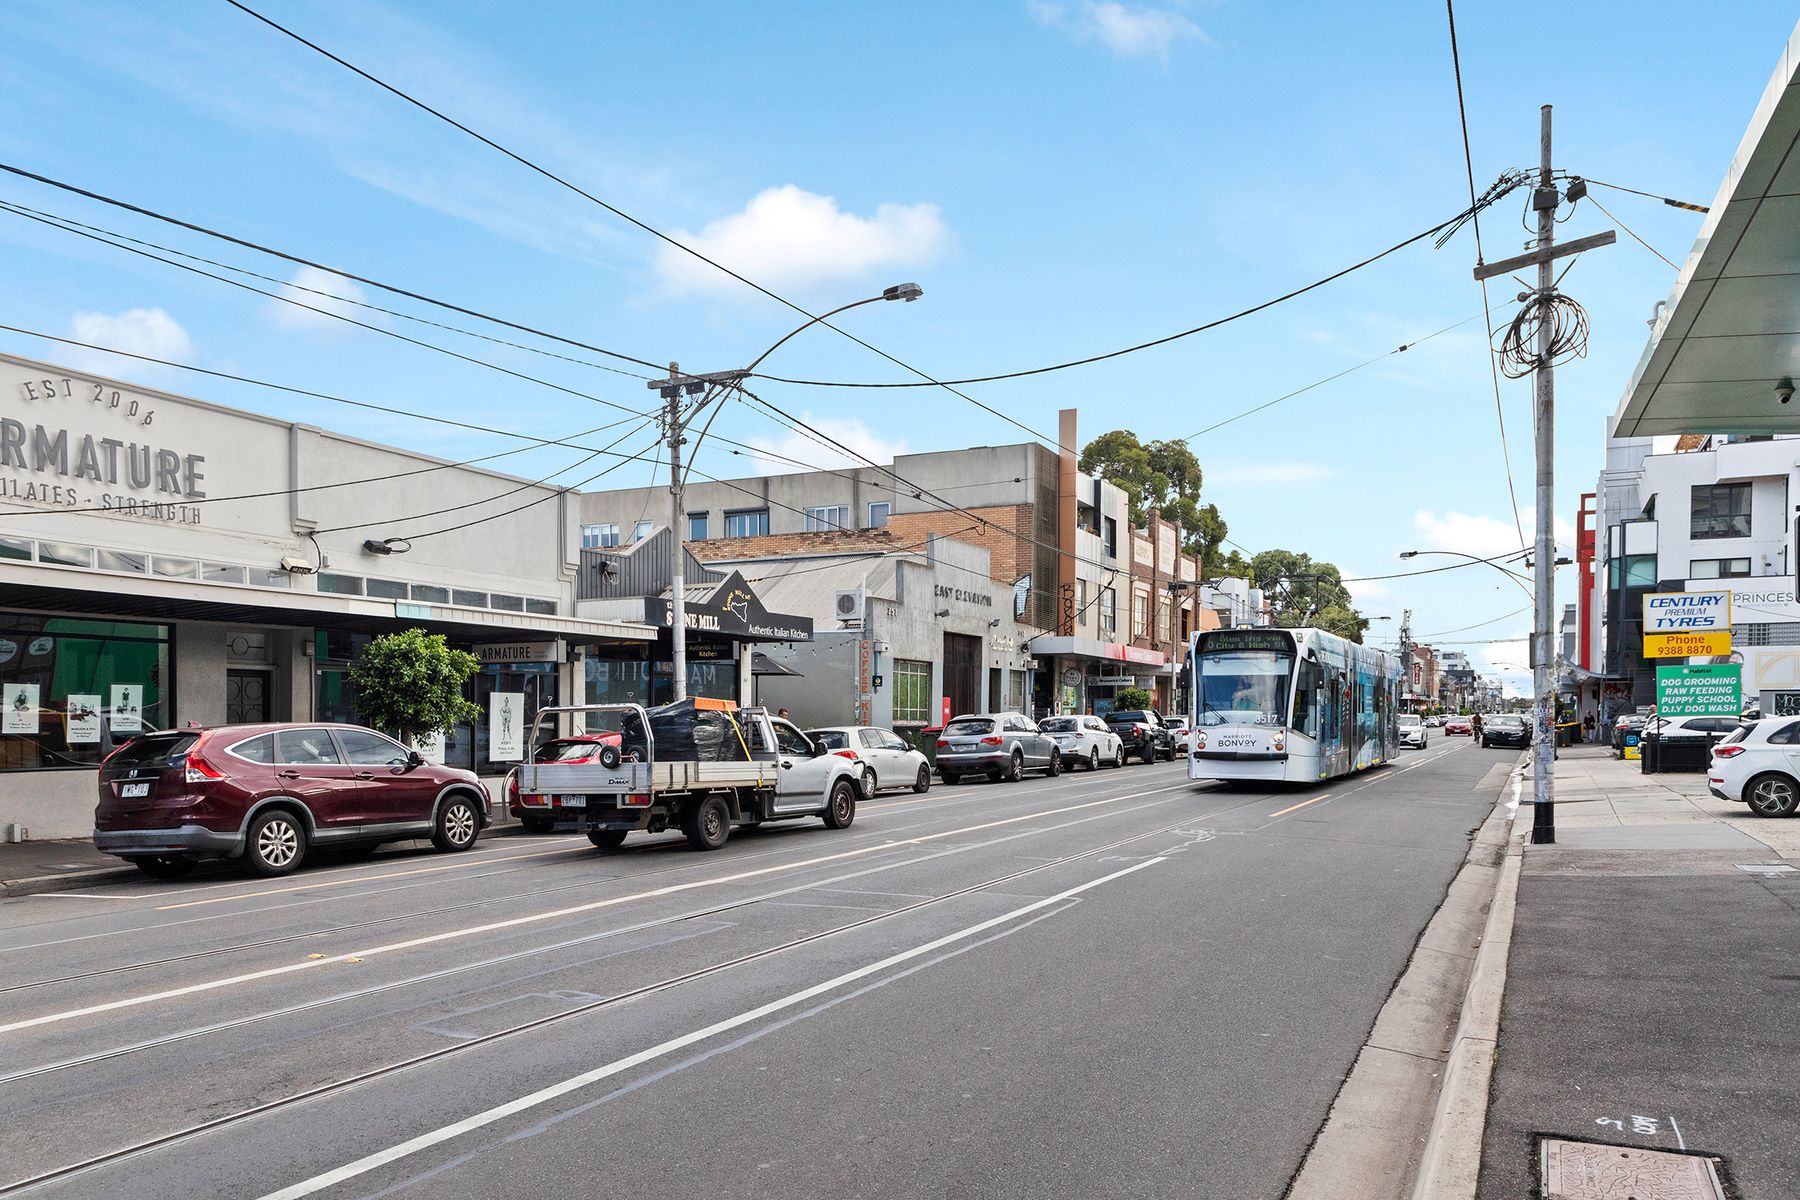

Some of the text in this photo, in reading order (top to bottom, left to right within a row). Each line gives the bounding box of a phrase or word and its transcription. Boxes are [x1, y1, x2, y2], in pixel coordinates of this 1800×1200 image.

[24, 379, 155, 426] EST 2006
[102, 493, 201, 524] STRENGTH
[934, 584, 992, 607] EAST ELEVATION
[1650, 595, 1724, 608] CENTURY
[1664, 608, 1706, 616] PREMIUM
[666, 611, 721, 631] SNE MILL
[1656, 616, 1715, 628] TYRES
[748, 623, 809, 640] Authentic Italian Kitchen
[1666, 635, 1705, 644] Phone
[689, 643, 712, 652] Authentic
[1249, 641, 1270, 649] High
[1658, 645, 1712, 655] 9388 8870
[482, 646, 530, 660] ARMATURE
[699, 650, 718, 658] Kitchen
[861, 640, 869, 694] COFFEE
[1661, 677, 1737, 687] DOG GROOMING
[1665, 686, 1733, 695] RAW FEEDING
[1661, 695, 1737, 704] PUPPY SCHOOL
[1662, 705, 1682, 713] D.I.Y
[1708, 704, 1737, 712] WASH
[1255, 714, 1278, 724] 3517
[1218, 739, 1257, 747] BONVOY
